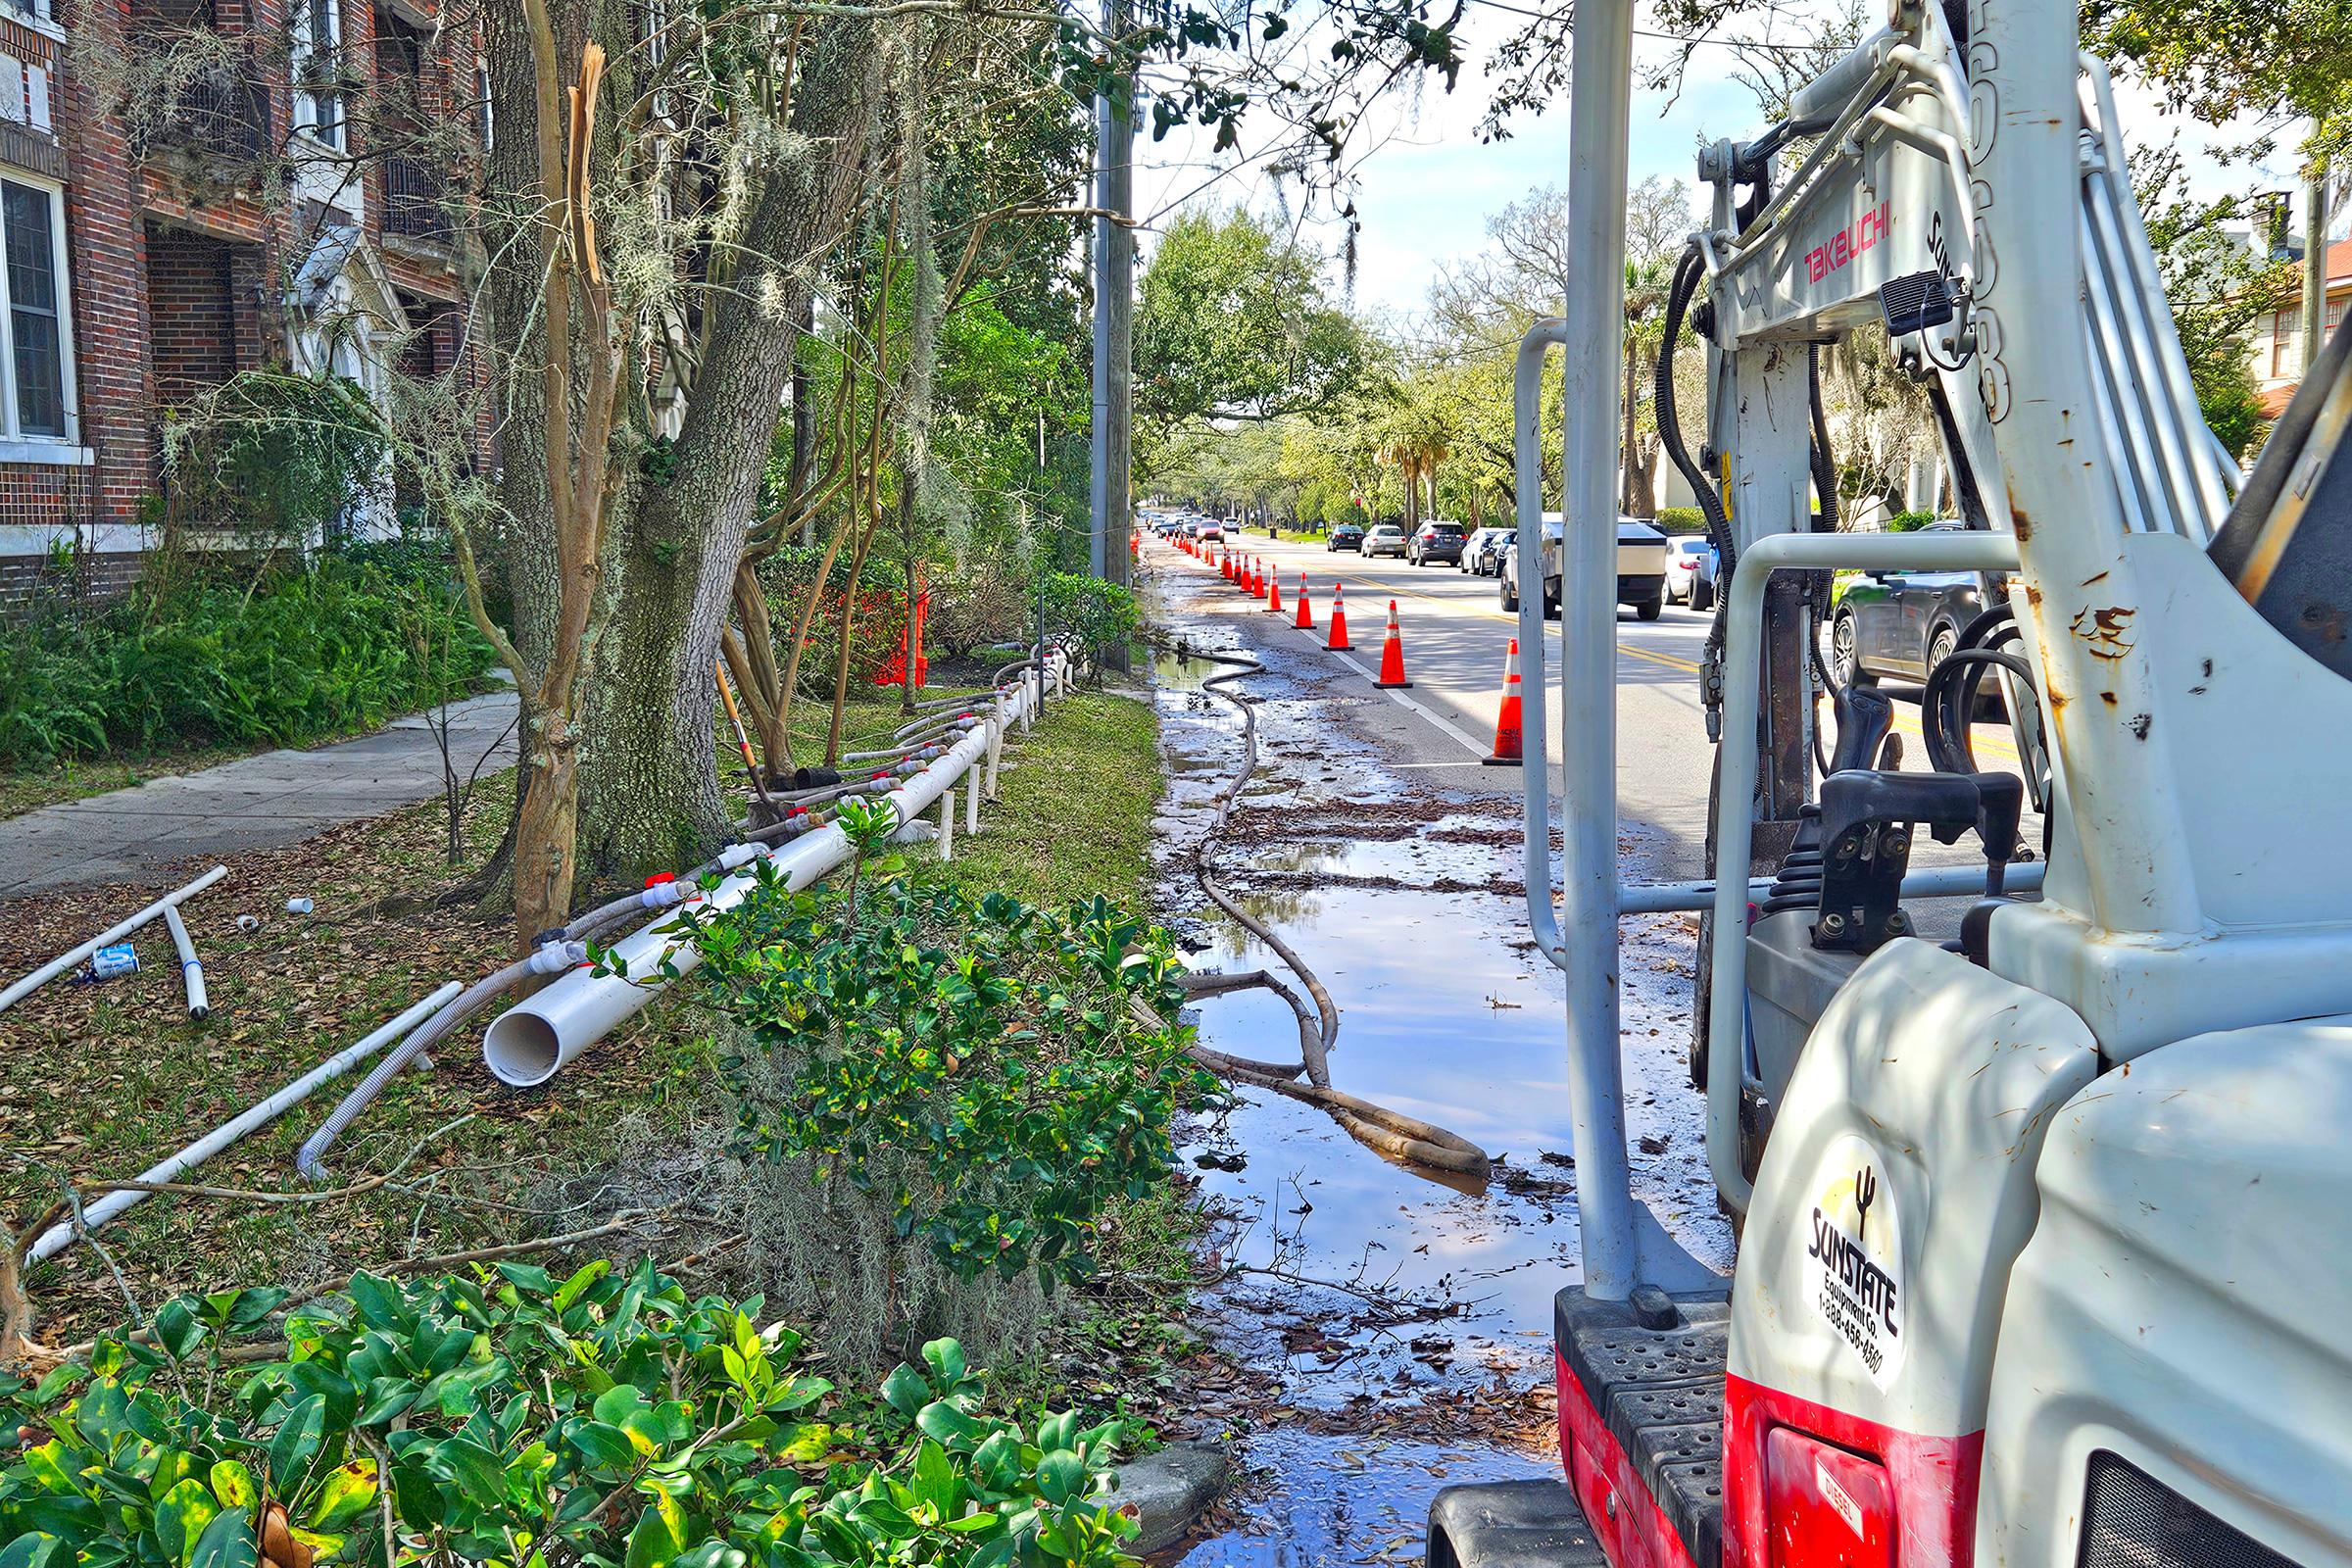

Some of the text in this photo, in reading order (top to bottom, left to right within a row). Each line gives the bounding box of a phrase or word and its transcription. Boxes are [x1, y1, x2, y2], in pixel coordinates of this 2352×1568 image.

[1927, 210, 1955, 282] SUN
[1808, 1206, 1898, 1338] SUNSTATE
[1824, 1270, 1878, 1340] Equipment Co.
[1819, 1292, 1884, 1375] 1-888-456-4560
[1825, 1477, 1853, 1521] DIESEL
